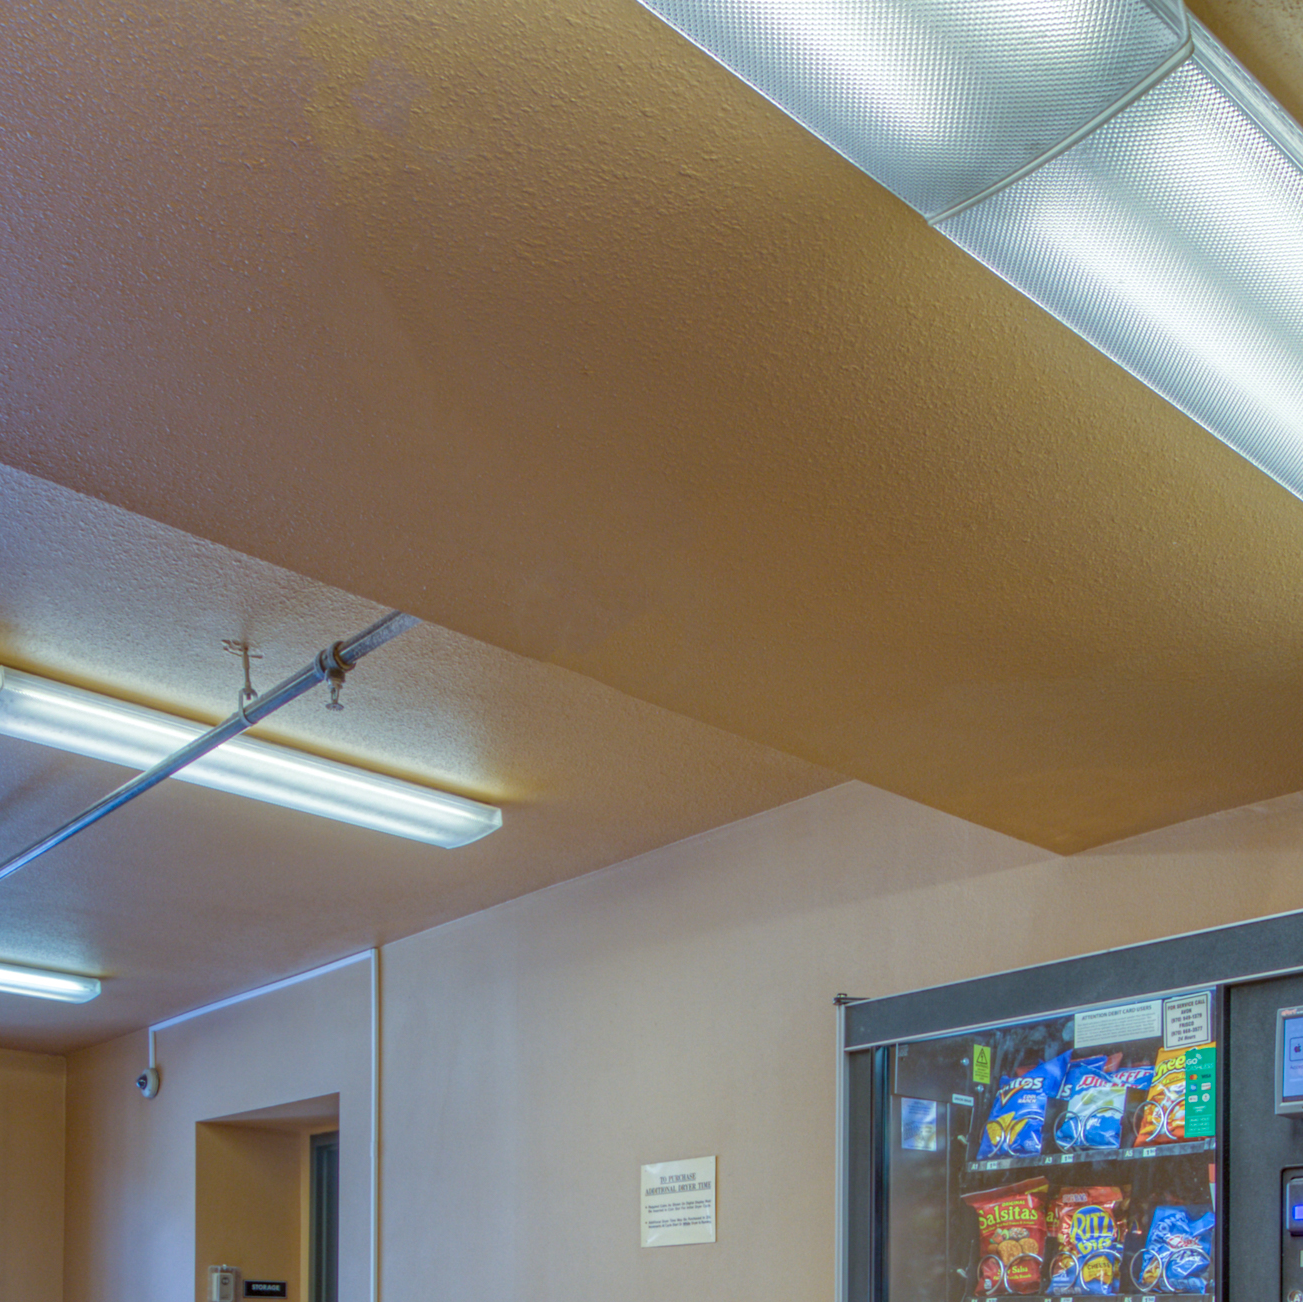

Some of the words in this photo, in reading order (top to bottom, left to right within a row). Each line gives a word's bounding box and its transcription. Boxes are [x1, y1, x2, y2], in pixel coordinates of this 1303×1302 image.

[1177, 1001, 1194, 1009] SERVICE
[1081, 1012, 1107, 1021] ATTENTION
[1108, 1009, 1122, 1018] DEBIT
[1122, 1007, 1136, 1015] CARD
[1136, 1004, 1152, 1013] USERS
[1178, 1021, 1195, 1029] FRISCO
[1186, 1058, 1198, 1066] GO
[660, 1176, 667, 1184] TO
[668, 1173, 696, 1182] PURCHASE
[645, 1185, 676, 1195] ADDITIONAL
[678, 1183, 696, 1192] DRYER
[698, 1181, 711, 1190] TIME
[979, 1205, 1038, 1229] Salsitas
[1070, 1212, 1113, 1243] RITZ
[1012, 1266, 1028, 1274] Salsa
[1087, 1262, 1111, 1271] CHEESE
